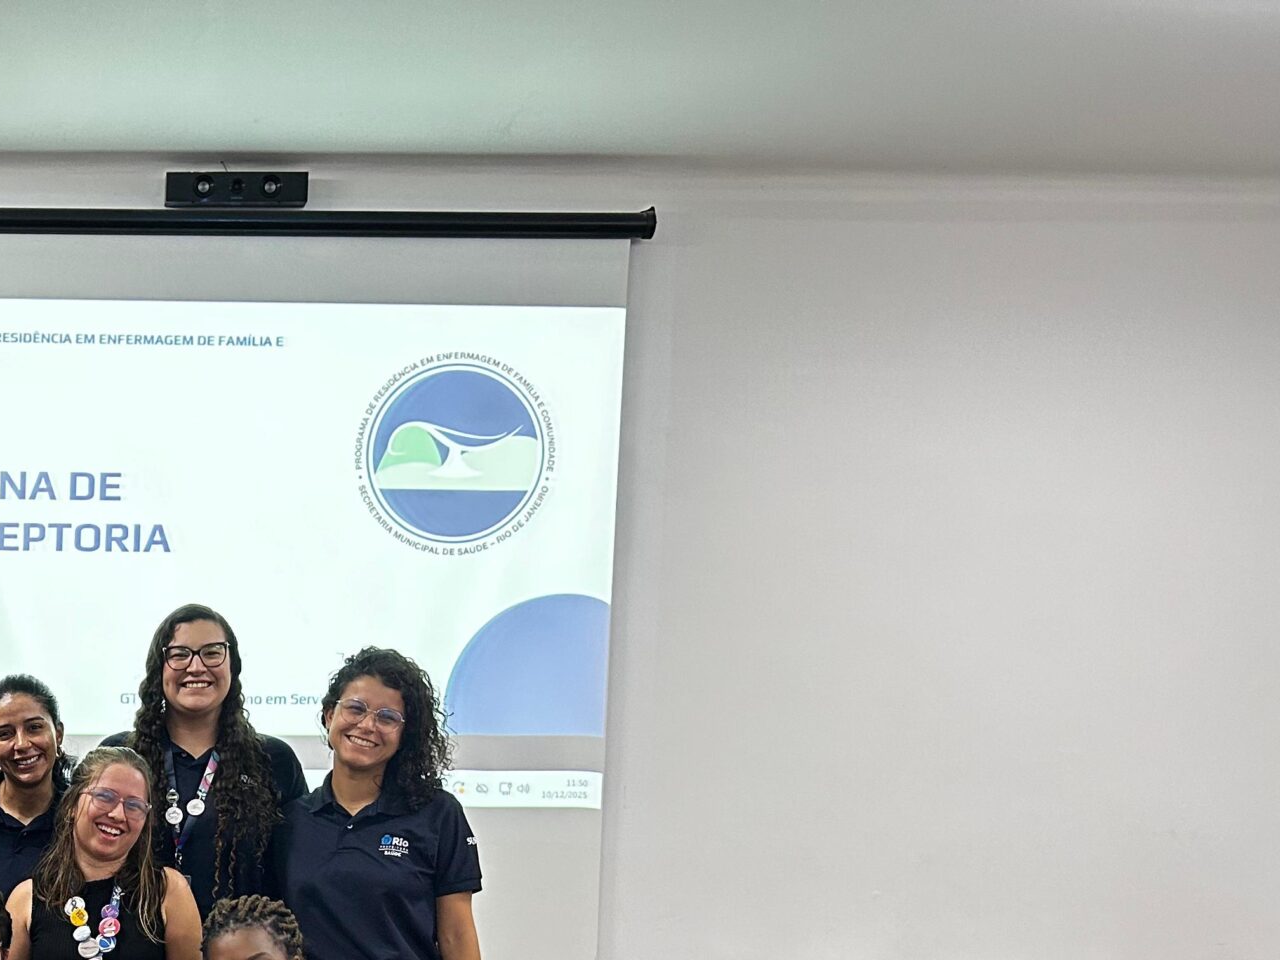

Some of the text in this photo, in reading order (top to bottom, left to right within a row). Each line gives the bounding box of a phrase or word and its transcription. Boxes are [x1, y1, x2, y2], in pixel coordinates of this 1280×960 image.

[75, 333, 96, 344] EM
[99, 334, 194, 345] ENFERMAGEM
[197, 335, 215, 346] DE
[218, 334, 272, 347] FAMÍLIA
[276, 336, 284, 347] E
[355, 417, 369, 470] PROGRAMA
[365, 402, 377, 416] DE
[373, 362, 419, 406] RESIDÊNCIA
[420, 356, 435, 367] EM
[436, 352, 501, 369] ENFERMAGEM
[501, 362, 515, 375] DE
[513, 371, 540, 403] FAMÍLIA
[541, 410, 555, 473] COMUNIDADE
[69, 472, 122, 501] DE
[358, 484, 394, 534] SECRETARIA
[393, 530, 440, 556] MUNICIPAL
[442, 548, 455, 556] DE
[496, 530, 513, 545] RIO
[511, 520, 525, 532] DE
[523, 485, 549, 523] JANEIRO
[265, 697, 287, 705] em
[290, 694, 320, 705] Serv
[392, 837, 409, 847] Rio
